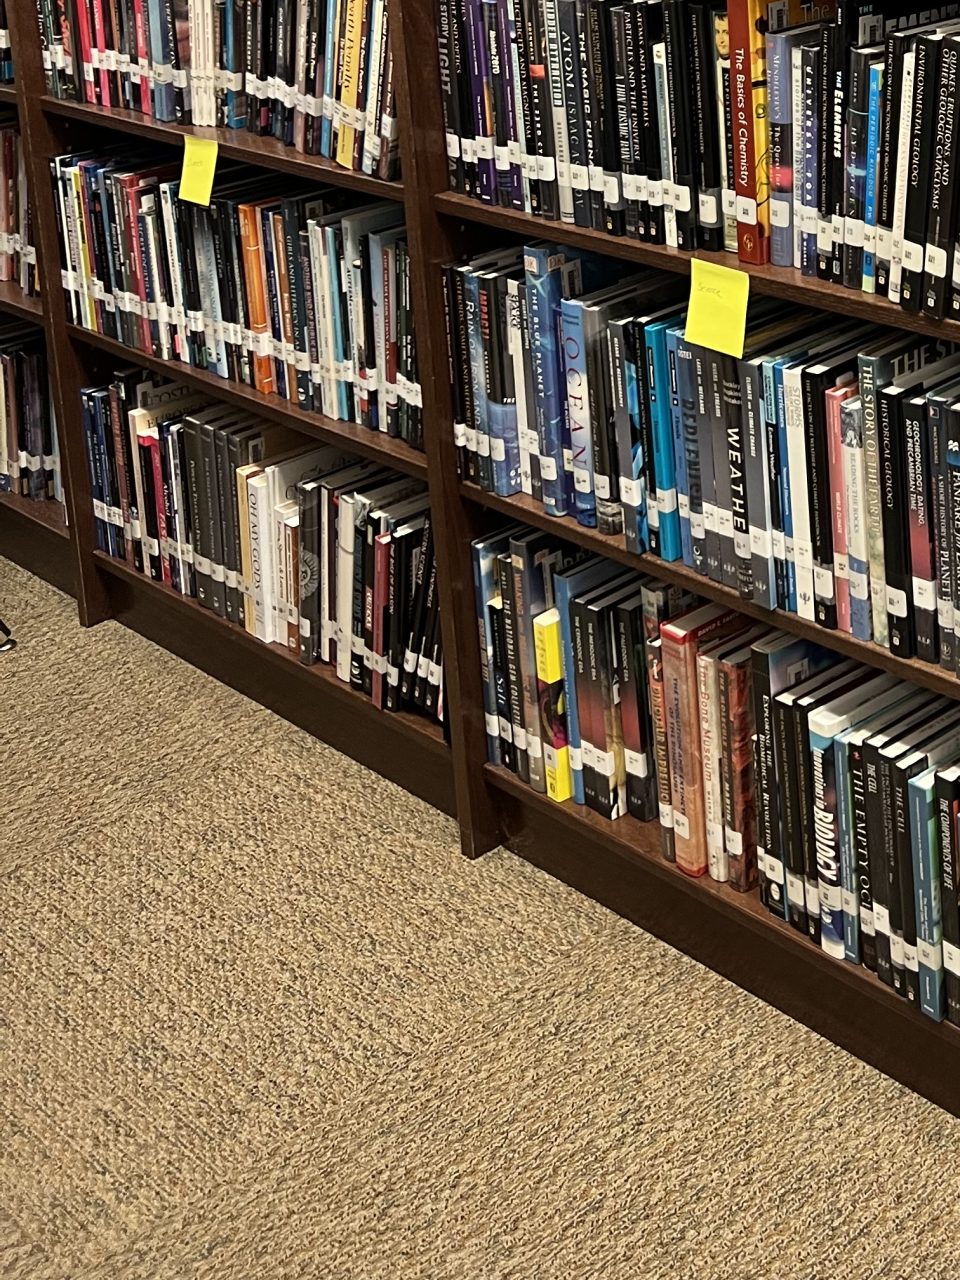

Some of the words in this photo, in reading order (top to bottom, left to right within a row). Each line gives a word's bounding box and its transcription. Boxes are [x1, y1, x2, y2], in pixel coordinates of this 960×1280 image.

[735, 72, 746, 107] Basics
[834, 90, 843, 158] ELEMENTS
[735, 127, 748, 186] Chemistry
[536, 353, 545, 397] PLANET
